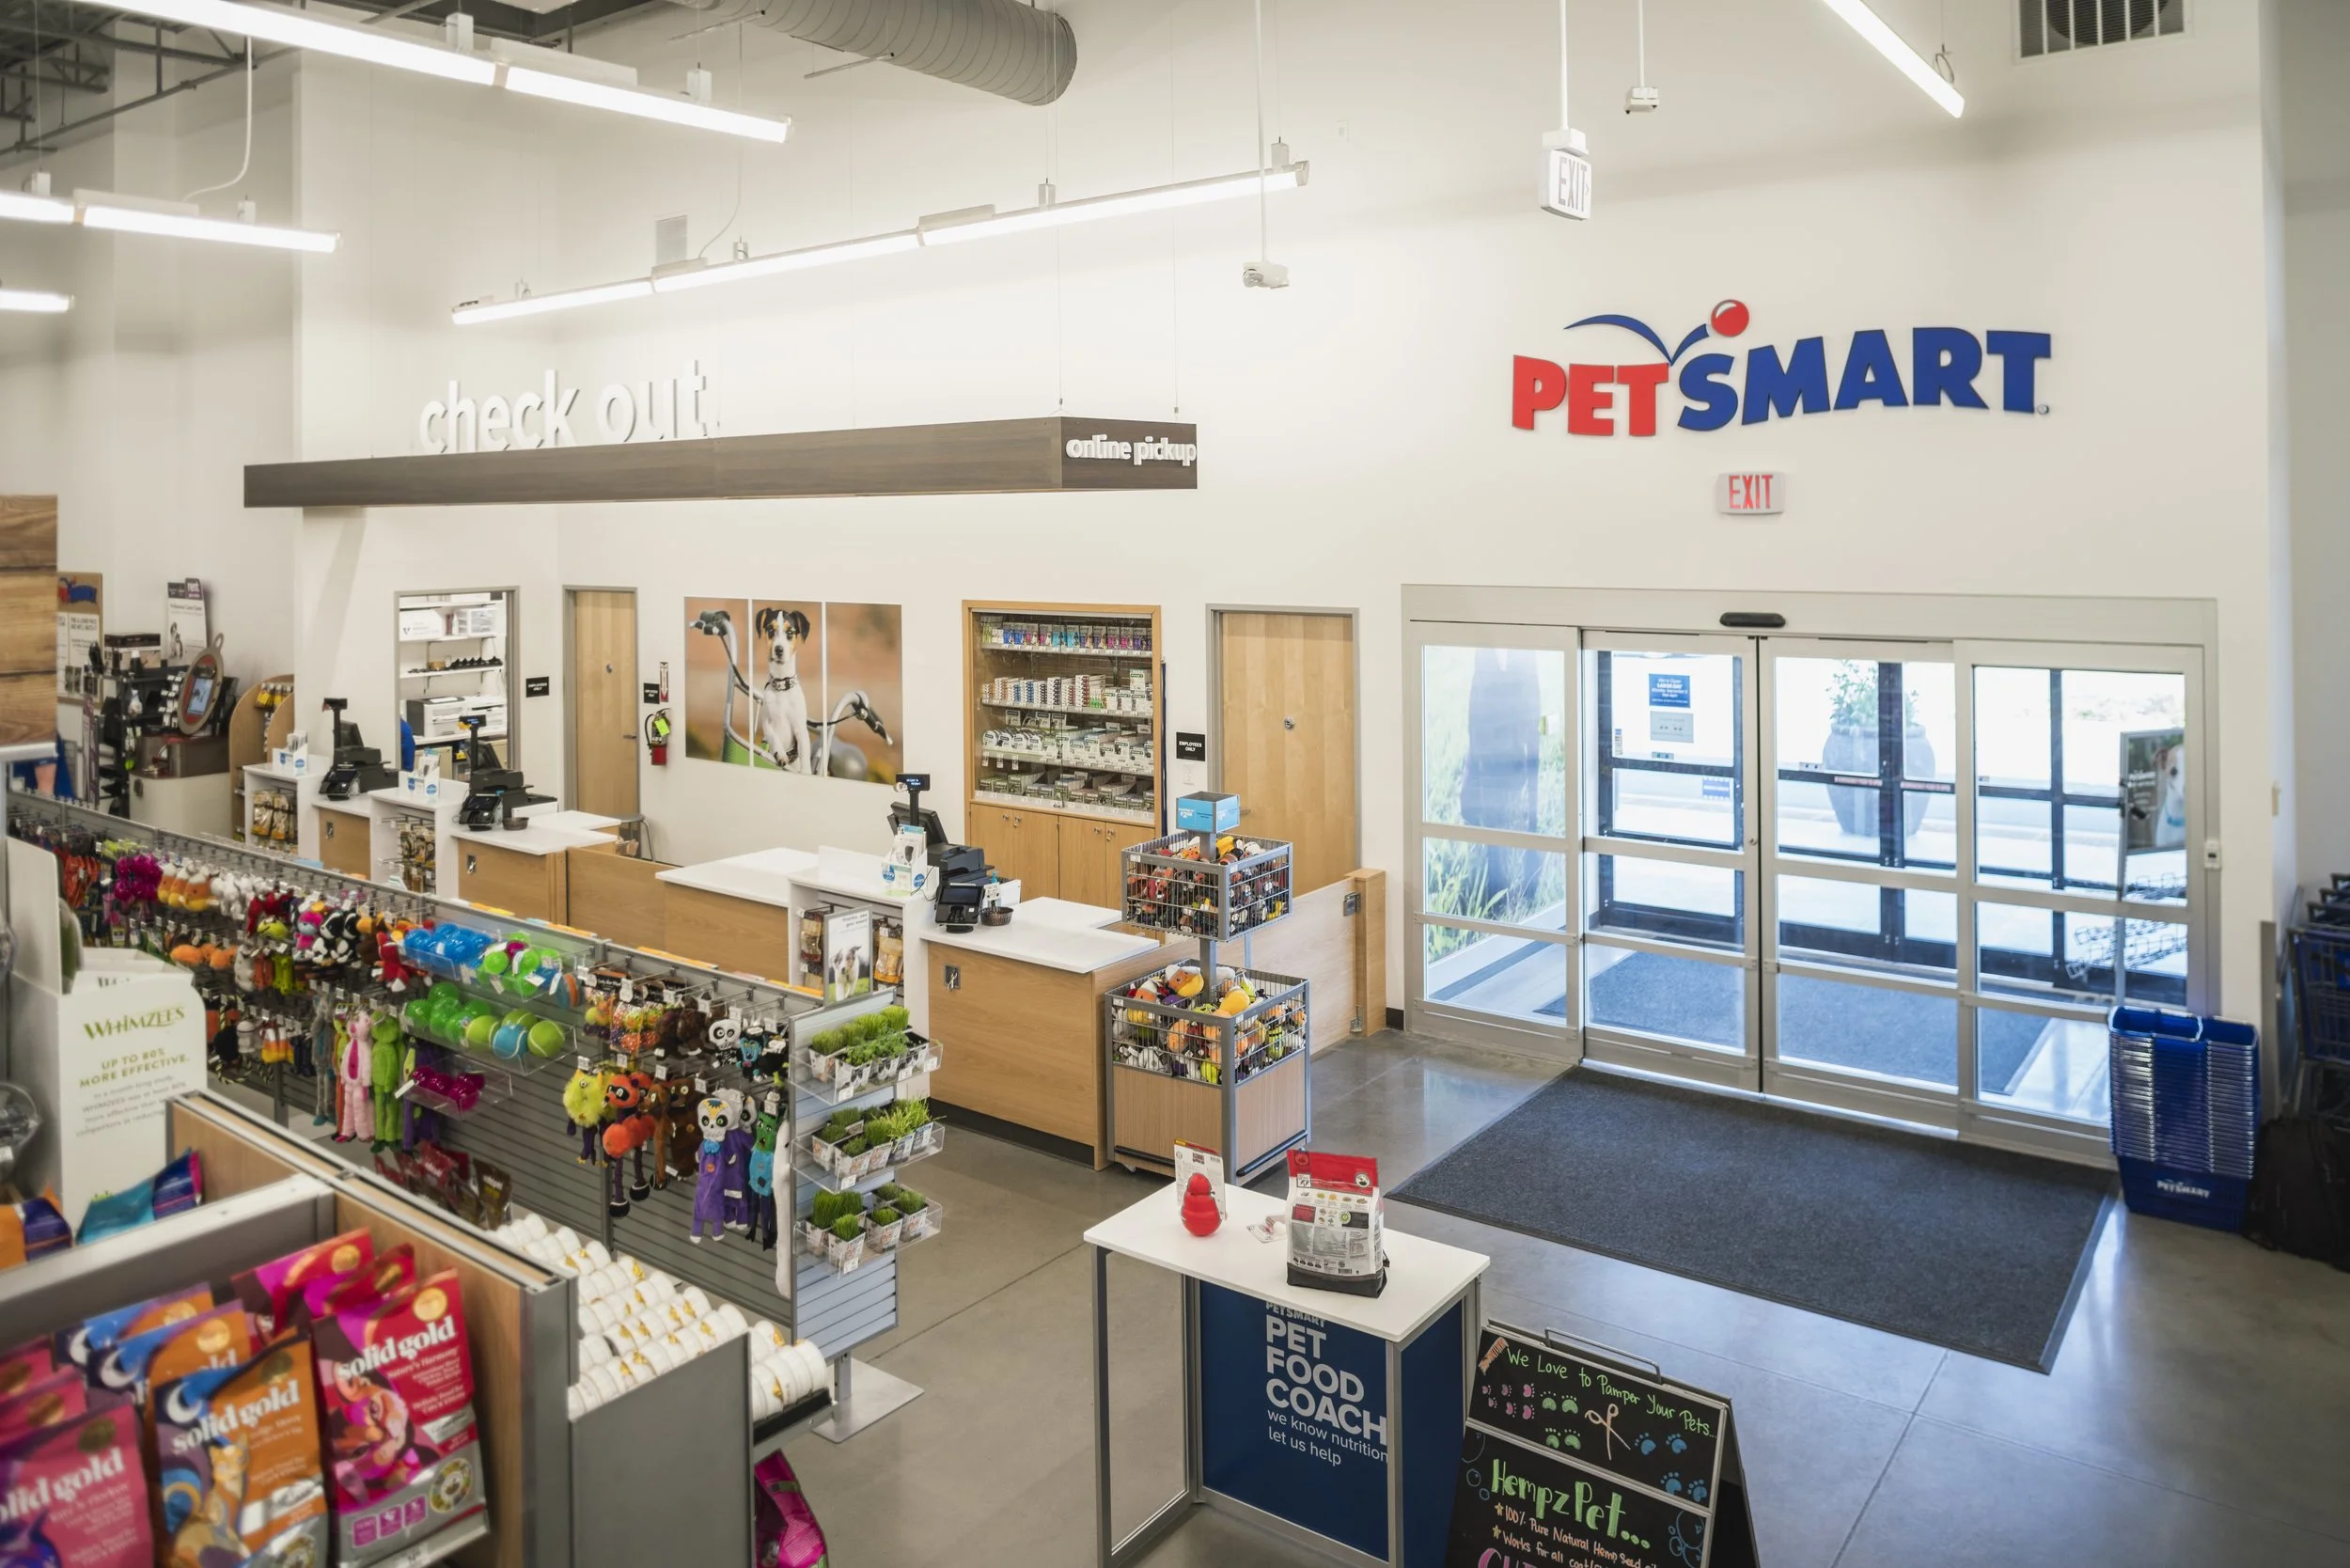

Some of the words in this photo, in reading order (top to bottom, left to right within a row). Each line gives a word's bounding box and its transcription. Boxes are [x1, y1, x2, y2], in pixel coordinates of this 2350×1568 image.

[1559, 156, 1588, 212] EXIT
[419, 369, 580, 455] check
[598, 358, 707, 444] out
[1512, 326, 2052, 437] PETSMART
[1066, 434, 1132, 460] online
[1134, 435, 1197, 467] pickup
[1728, 474, 1774, 510] EXIT
[83, 1006, 185, 1040] WHIMZEES
[79, 1071, 117, 1089] MORE
[122, 1054, 190, 1077] EFFECTIVE.
[102, 1057, 118, 1070] UP
[122, 1054, 138, 1065] TO
[2156, 1180, 2210, 1199] PETSMART
[337, 1337, 397, 1381] solid
[398, 1315, 456, 1361] gold
[1266, 1314, 1327, 1358] PET
[1266, 1345, 1364, 1403] FOOD
[1507, 1348, 1529, 1367] We
[1537, 1355, 1568, 1379] Love
[1579, 1367, 1591, 1388] to
[1597, 1374, 1640, 1406] Pamper
[1647, 1394, 1675, 1419] Your
[172, 1403, 239, 1453] solid
[238, 1379, 300, 1429] gold
[1266, 1378, 1387, 1447] COACH
[1267, 1409, 1287, 1425] we
[1291, 1416, 1327, 1440] know
[1331, 1433, 1388, 1464] nutrition
[1269, 1426, 1287, 1445] let
[1290, 1437, 1307, 1452] us
[1310, 1441, 1341, 1466] help
[0, 1477, 51, 1523] olid
[52, 1446, 124, 1502] gold
[1503, 1530, 1531, 1553] Works
[1536, 1541, 1549, 1558] for
[1551, 1551, 1564, 1564] all
[1529, 1517, 1549, 1536] Pure
[1553, 1527, 1589, 1550] Natural
[1593, 1541, 1618, 1562] Hemp
[1620, 1553, 1641, 1568] Seed
